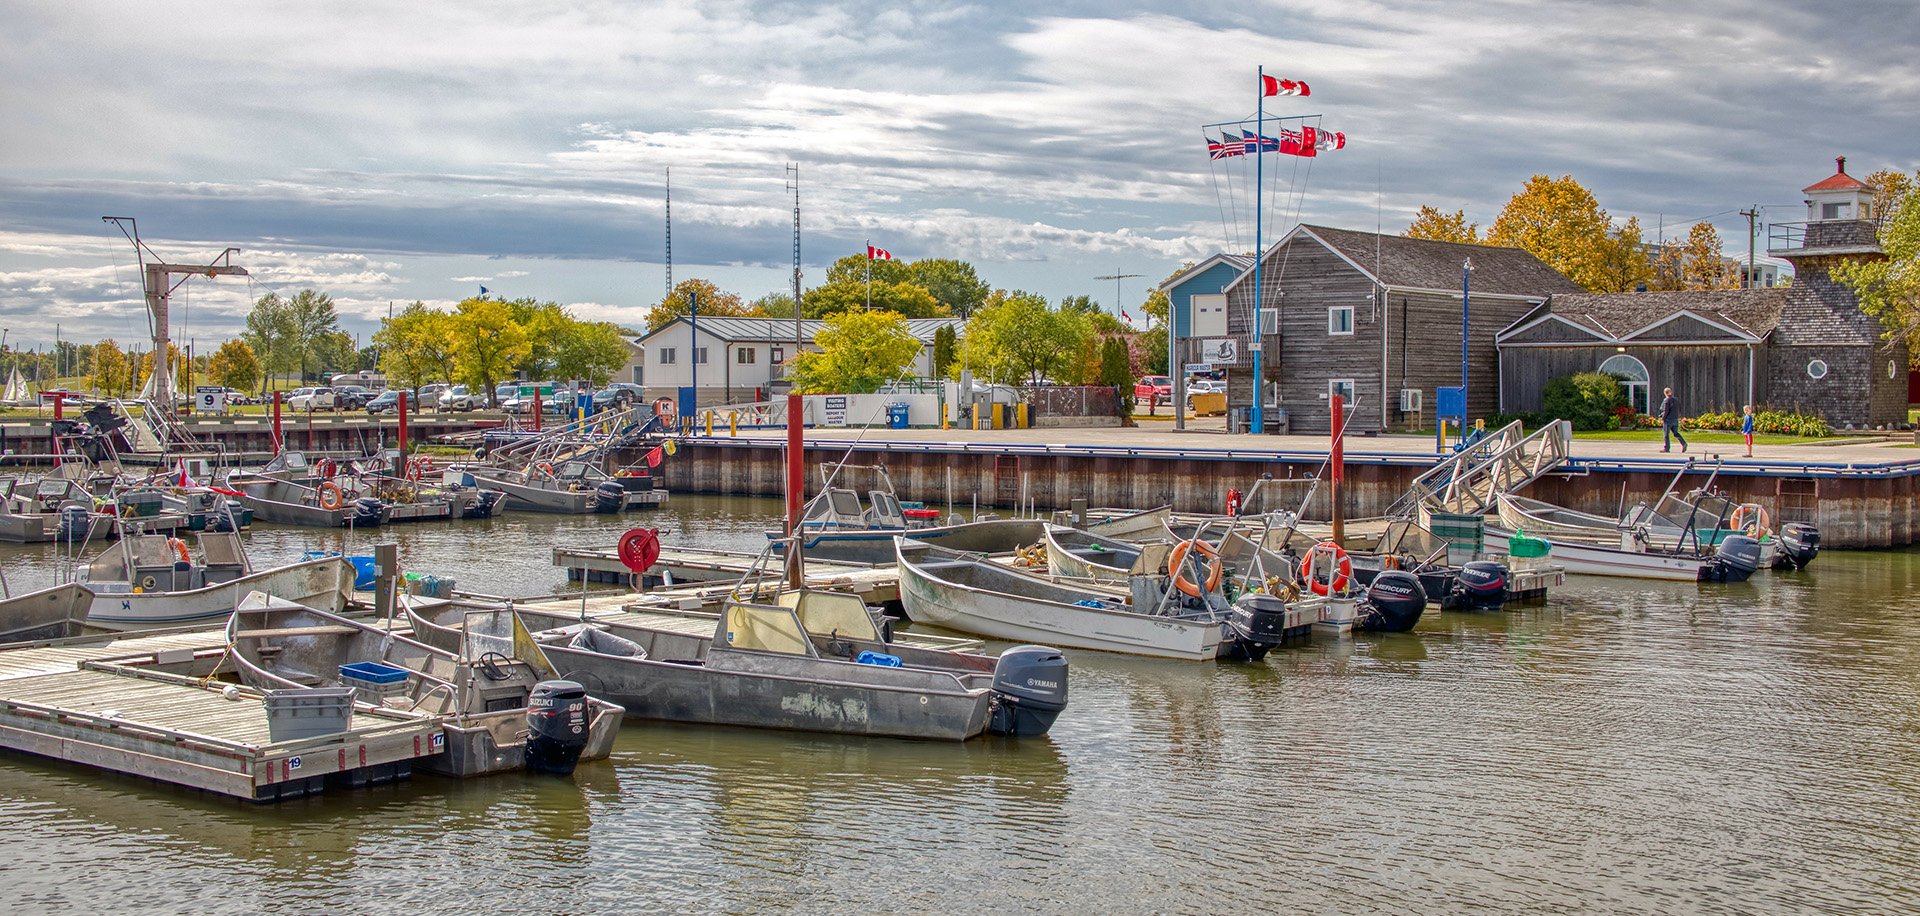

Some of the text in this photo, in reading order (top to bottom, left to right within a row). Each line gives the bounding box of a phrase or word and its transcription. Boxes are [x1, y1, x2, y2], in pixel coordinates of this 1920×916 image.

[204, 394, 215, 406] 9
[1463, 567, 1491, 579] EVINRUDE
[1374, 583, 1412, 594] MERCURY
[1231, 603, 1254, 619] MERCURY
[1034, 679, 1058, 689] YAMAHA
[529, 698, 553, 707] SUZUKI
[569, 703, 583, 712] 90
[433, 734, 444, 745] 17
[289, 757, 301, 768] 19
